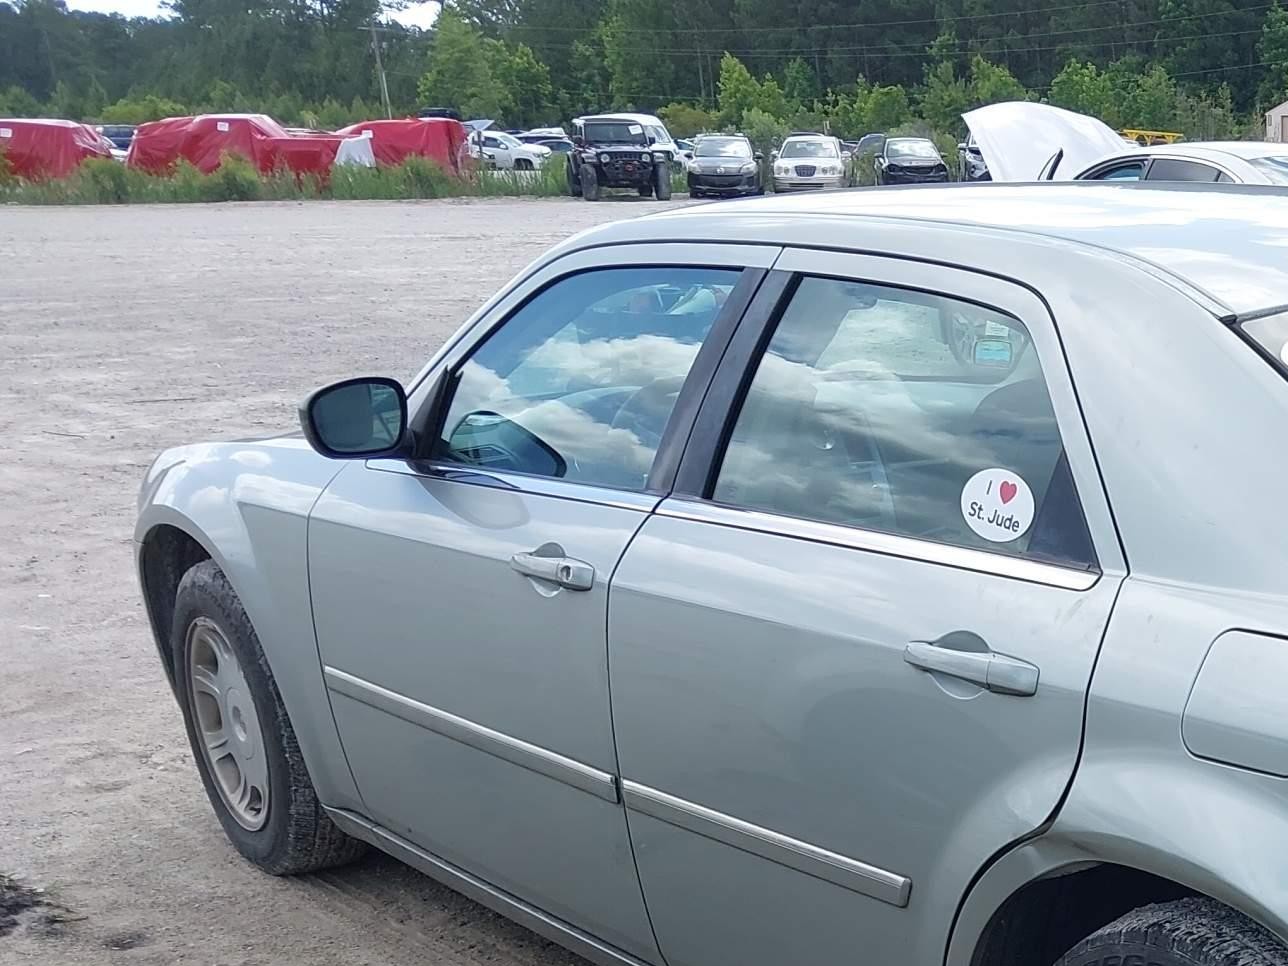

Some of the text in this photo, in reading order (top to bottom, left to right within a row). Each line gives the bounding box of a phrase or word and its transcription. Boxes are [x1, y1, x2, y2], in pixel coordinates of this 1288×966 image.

[986, 480, 993, 495] I
[968, 502, 1020, 533] St. Jude
